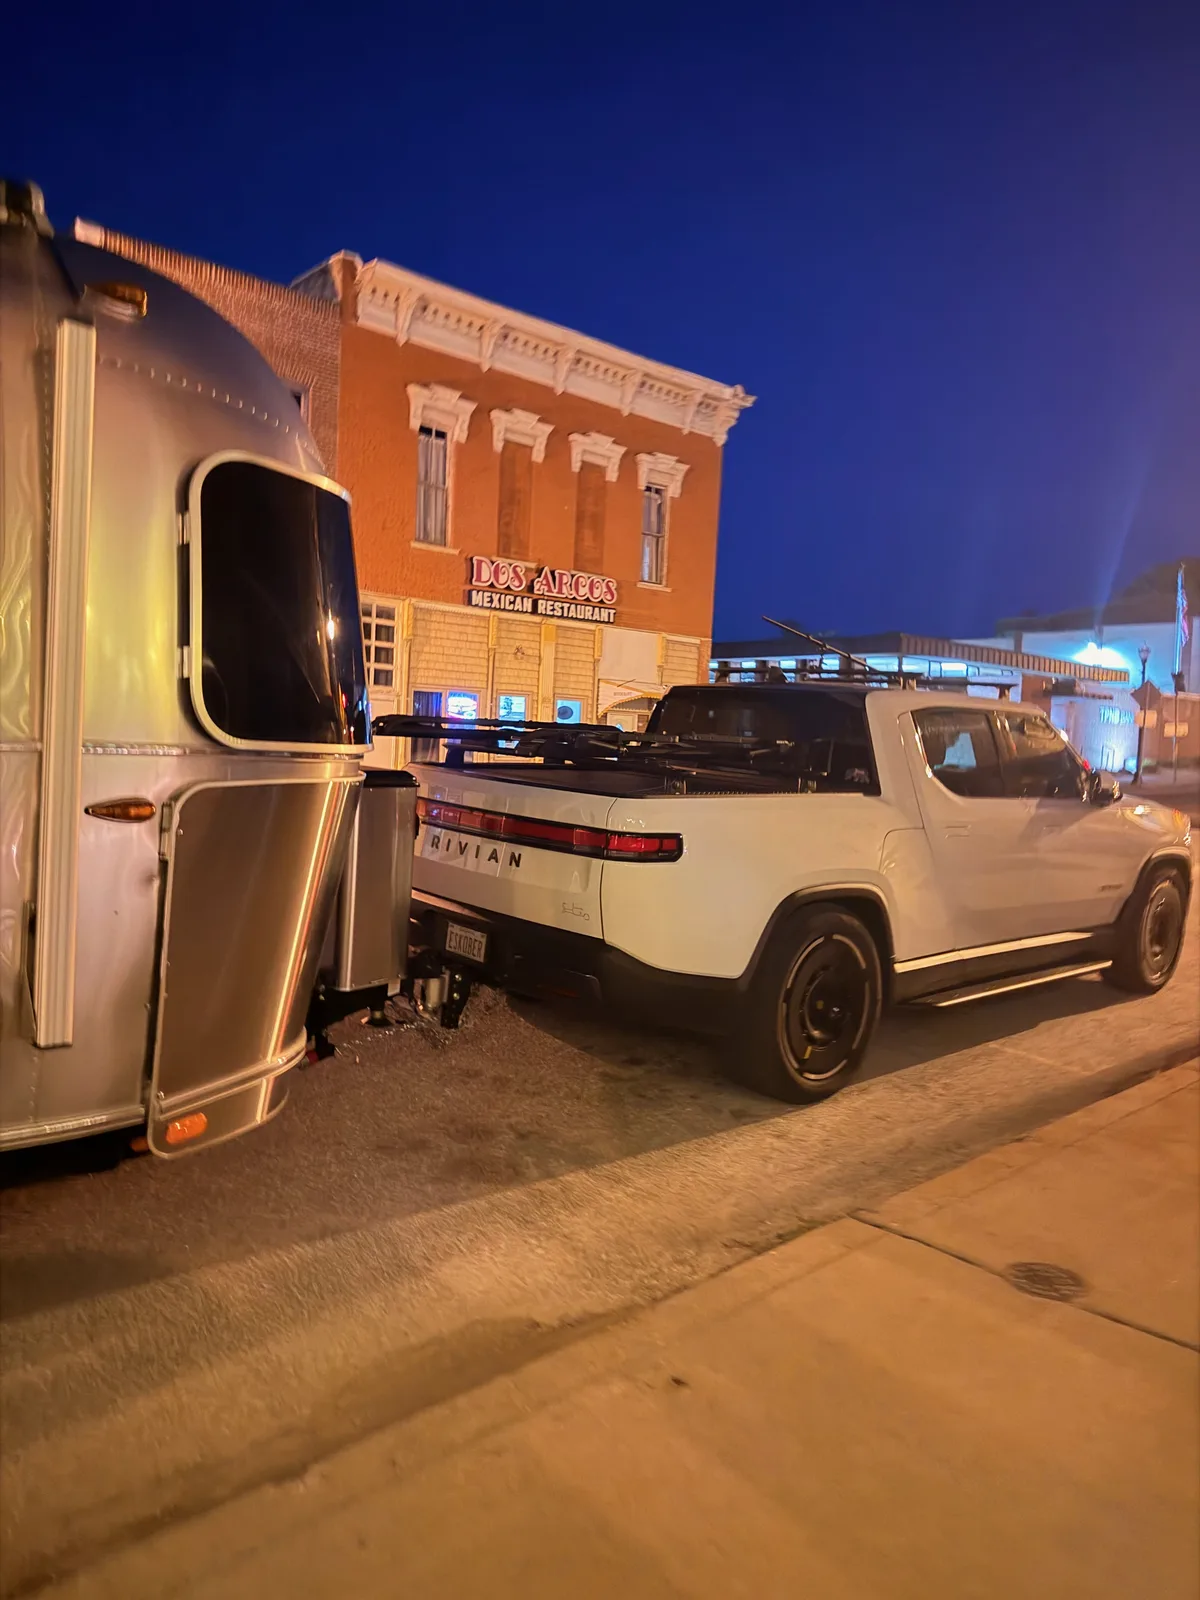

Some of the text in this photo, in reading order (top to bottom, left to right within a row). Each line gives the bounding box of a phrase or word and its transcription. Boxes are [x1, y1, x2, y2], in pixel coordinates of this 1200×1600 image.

[472, 556, 617, 604] DOS ARCOS
[471, 590, 616, 623] MEXICAN RESTAURANT
[431, 834, 522, 868] RIVIAN
